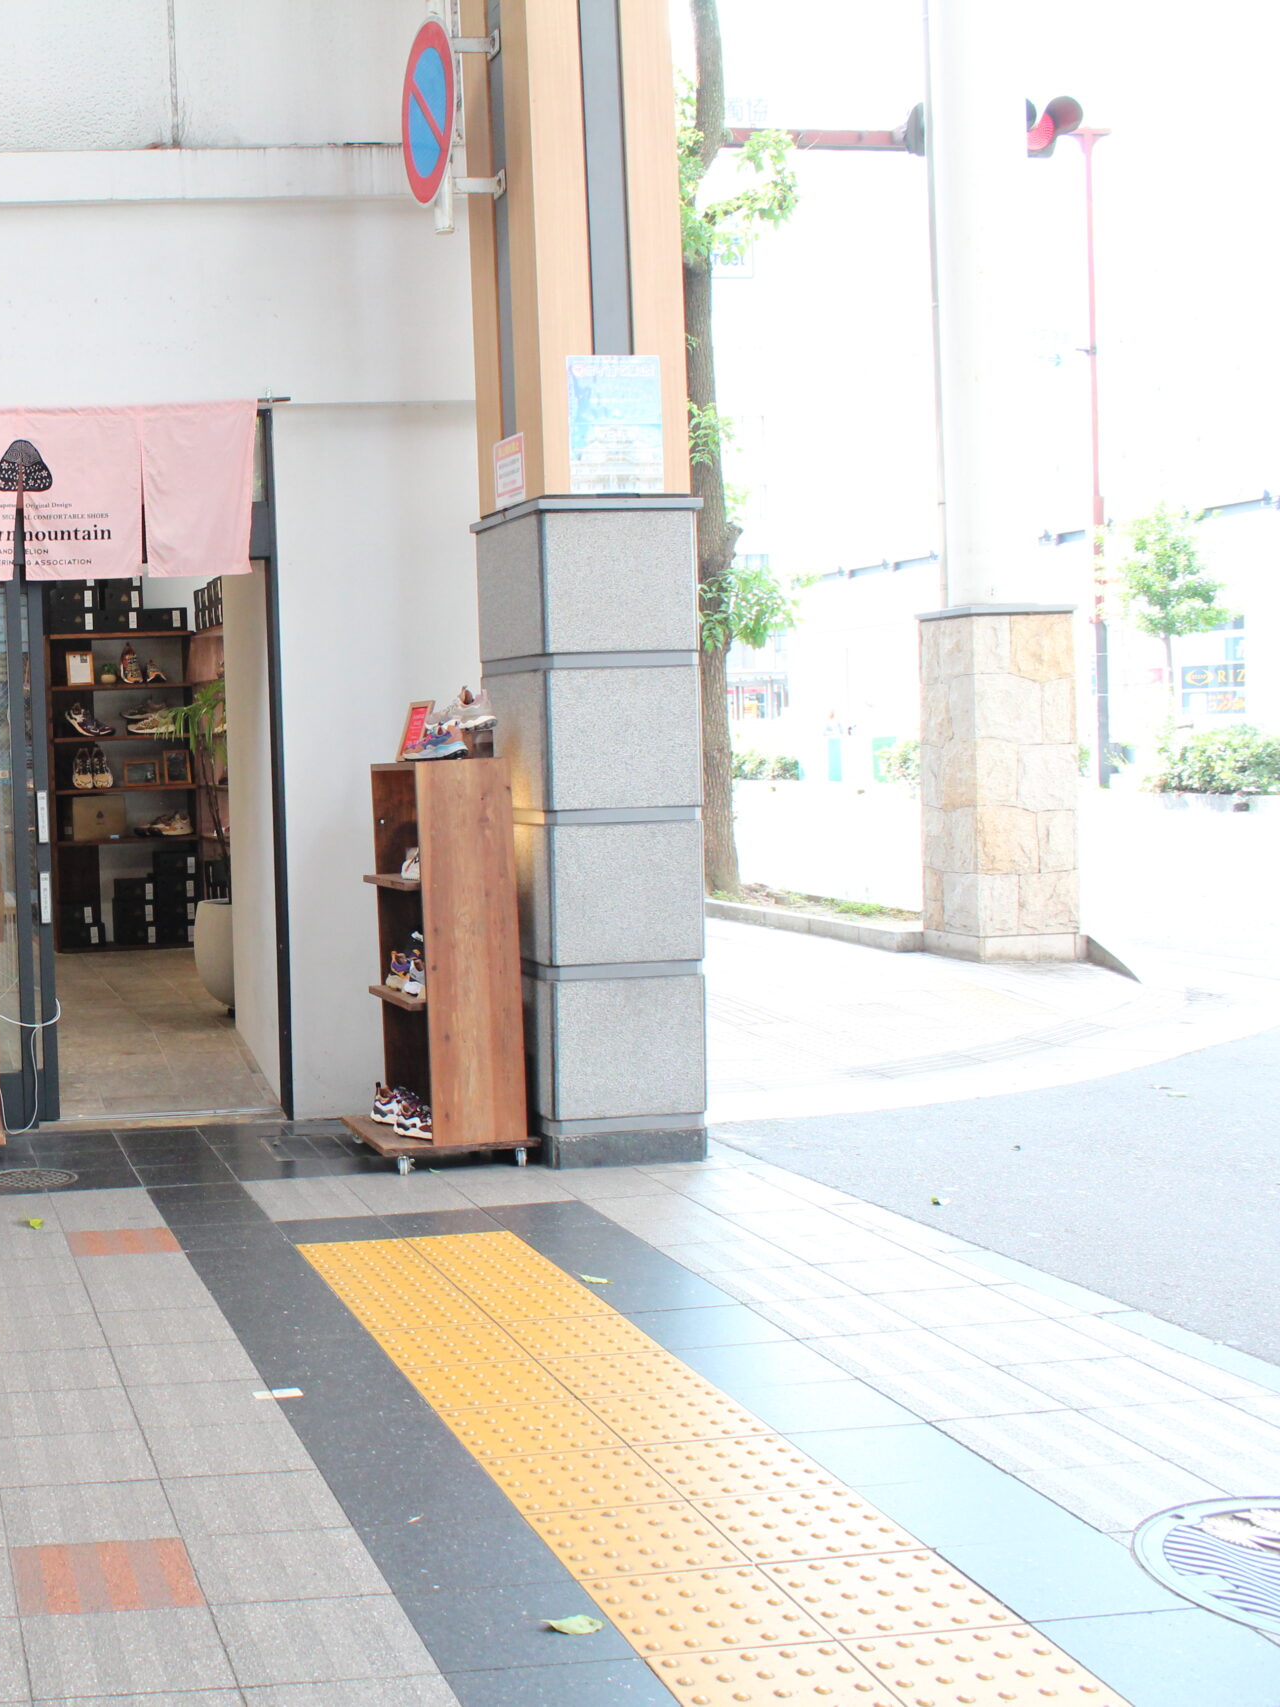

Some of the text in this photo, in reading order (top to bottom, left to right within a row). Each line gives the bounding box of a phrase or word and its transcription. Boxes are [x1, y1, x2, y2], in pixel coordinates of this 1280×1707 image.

[52, 501, 72, 509] Design
[33, 512, 85, 520] COMFORTABLE
[35, 558, 92, 566] ASSOCIATION
